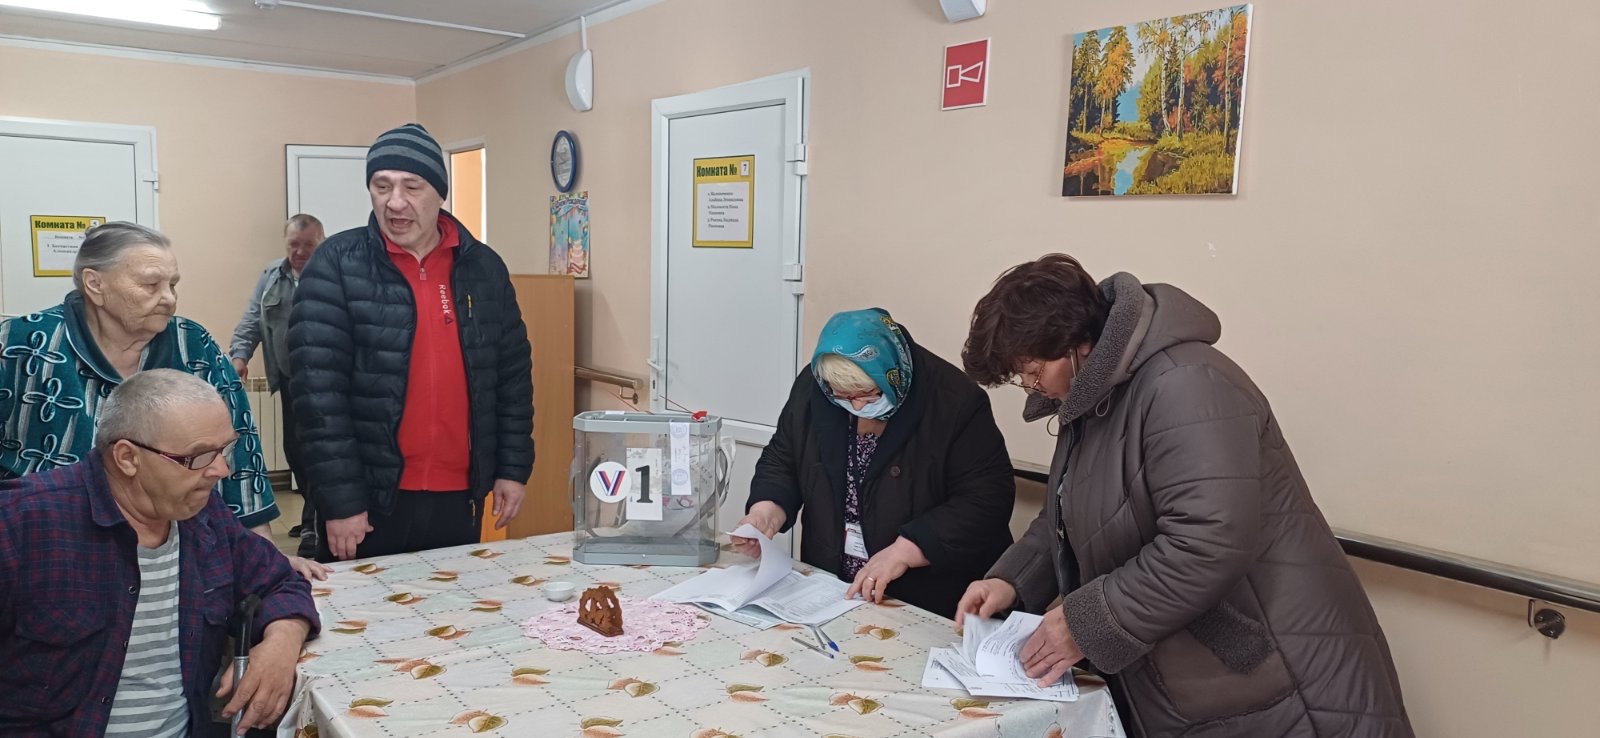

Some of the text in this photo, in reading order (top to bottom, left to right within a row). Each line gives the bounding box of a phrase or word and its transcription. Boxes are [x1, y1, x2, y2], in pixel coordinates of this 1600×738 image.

[696, 166, 728, 177] Комната
[729, 164, 737, 175] №
[34, 220, 75, 229] Комната
[438, 284, 451, 315] Reebok
[635, 465, 653, 503] 1
